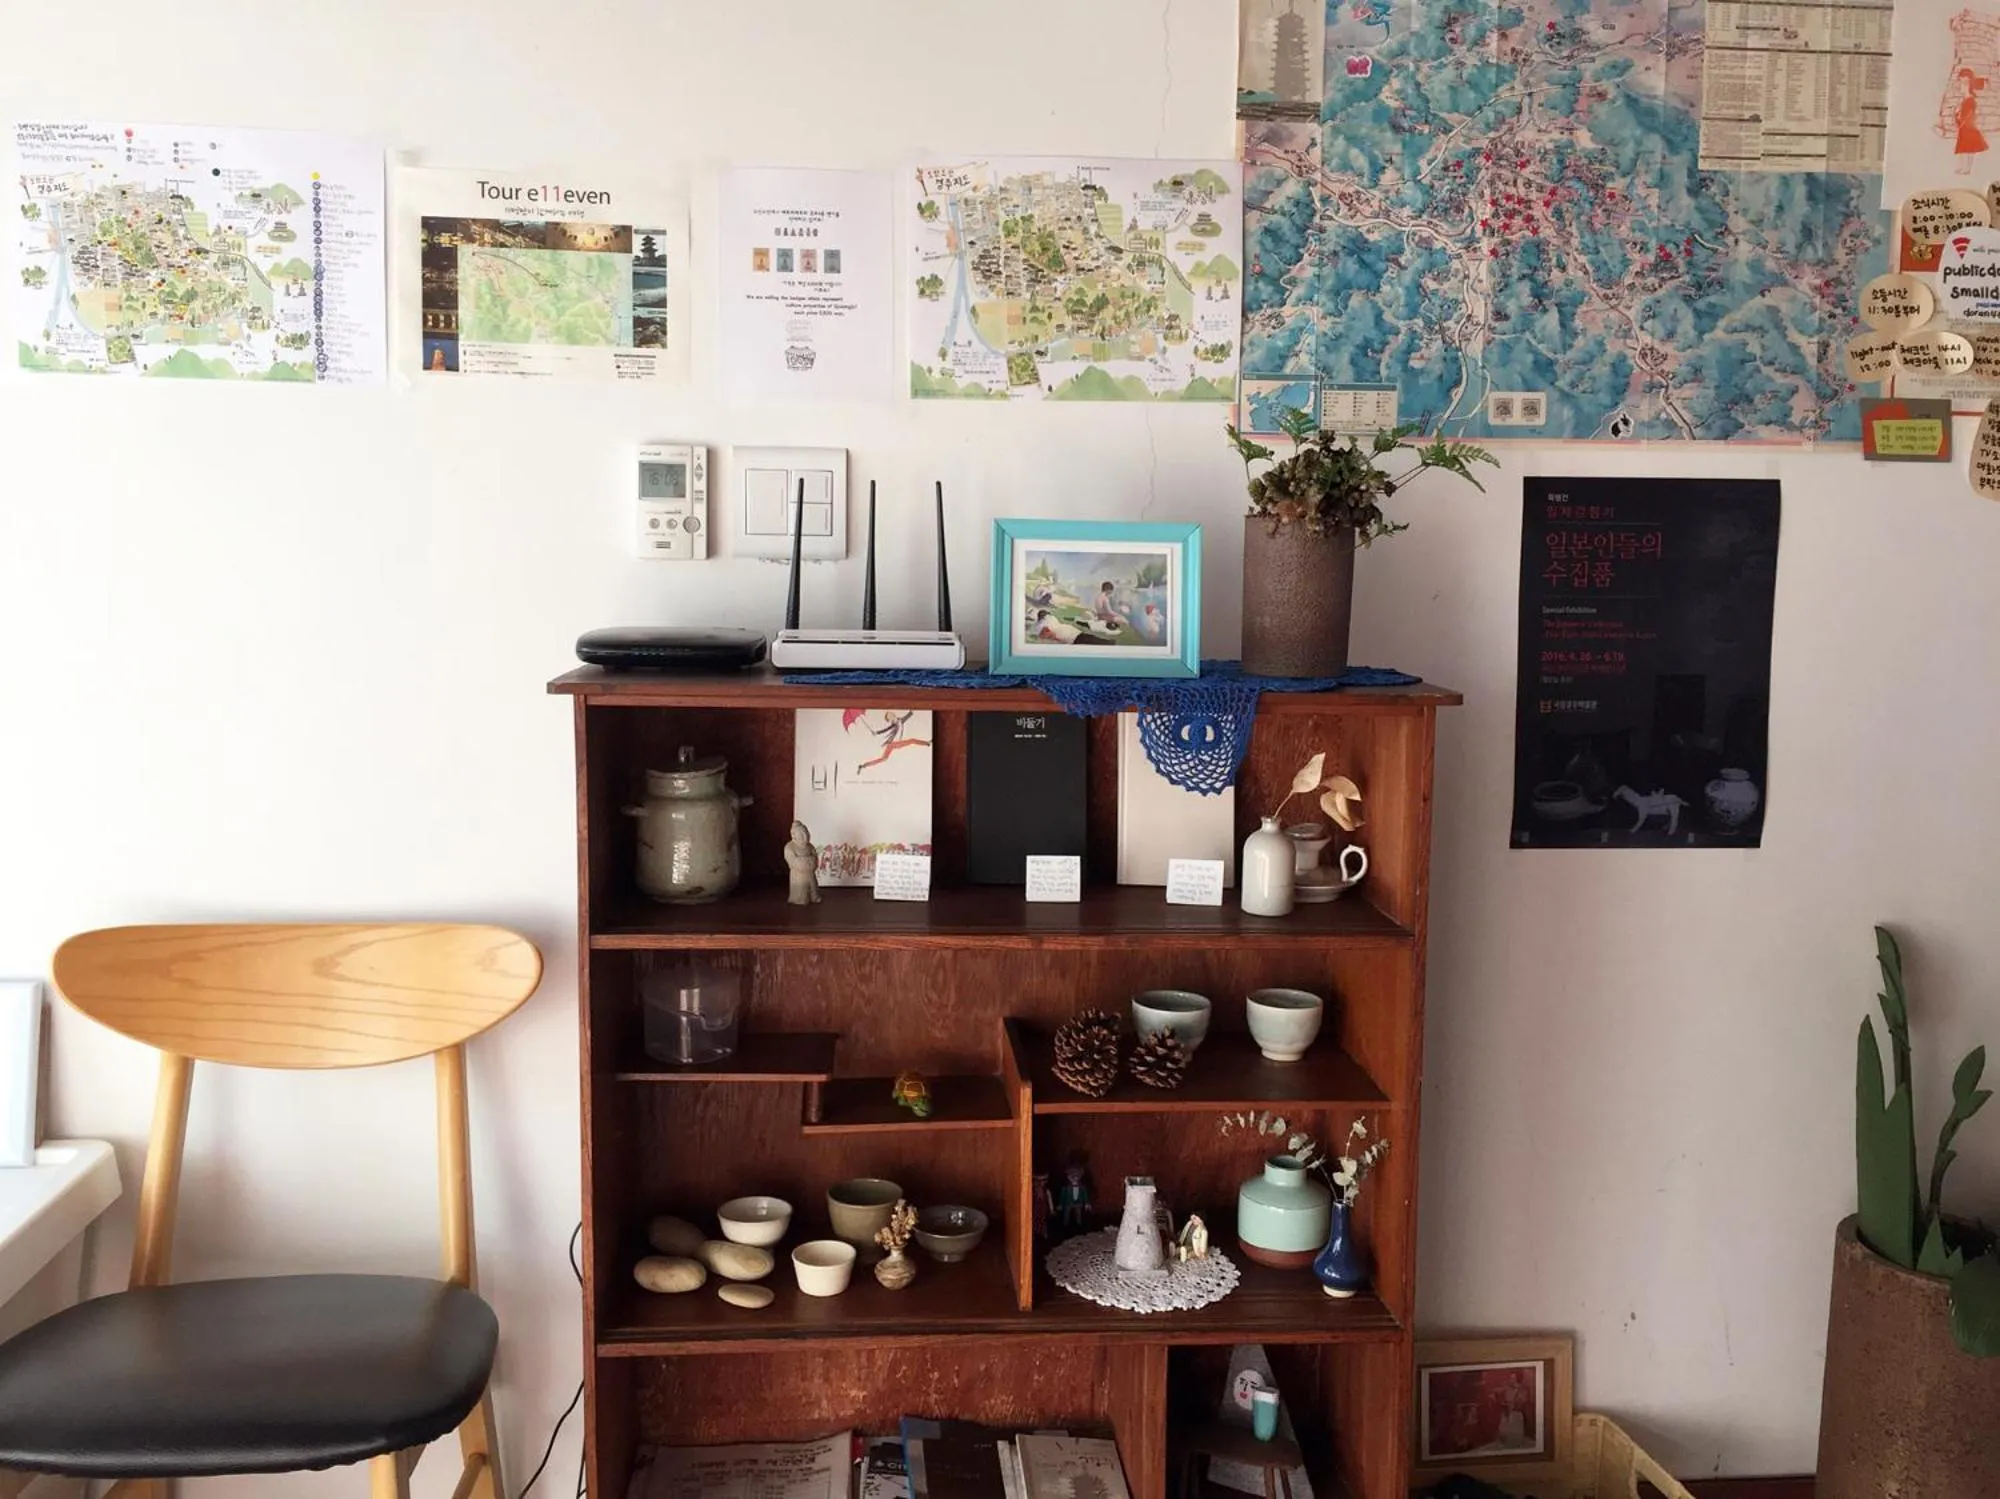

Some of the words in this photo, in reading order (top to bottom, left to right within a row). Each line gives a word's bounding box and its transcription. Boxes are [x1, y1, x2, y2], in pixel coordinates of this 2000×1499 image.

[935, 174, 971, 190] 경주지도
[476, 181, 522, 200] Tour
[527, 185, 611, 205] e11even
[1911, 196, 1951, 210] 조식시간
[1871, 287, 1909, 303] 소등시간
[1900, 343, 1930, 356] 체크인
[1937, 343, 1962, 353] 14시
[1902, 356, 1942, 370] 체크아웃
[1944, 355, 1967, 365] 11시
[1545, 530, 1663, 560] 일본인들의
[1541, 560, 1616, 588] 수집품
[811, 760, 839, 799] 비
